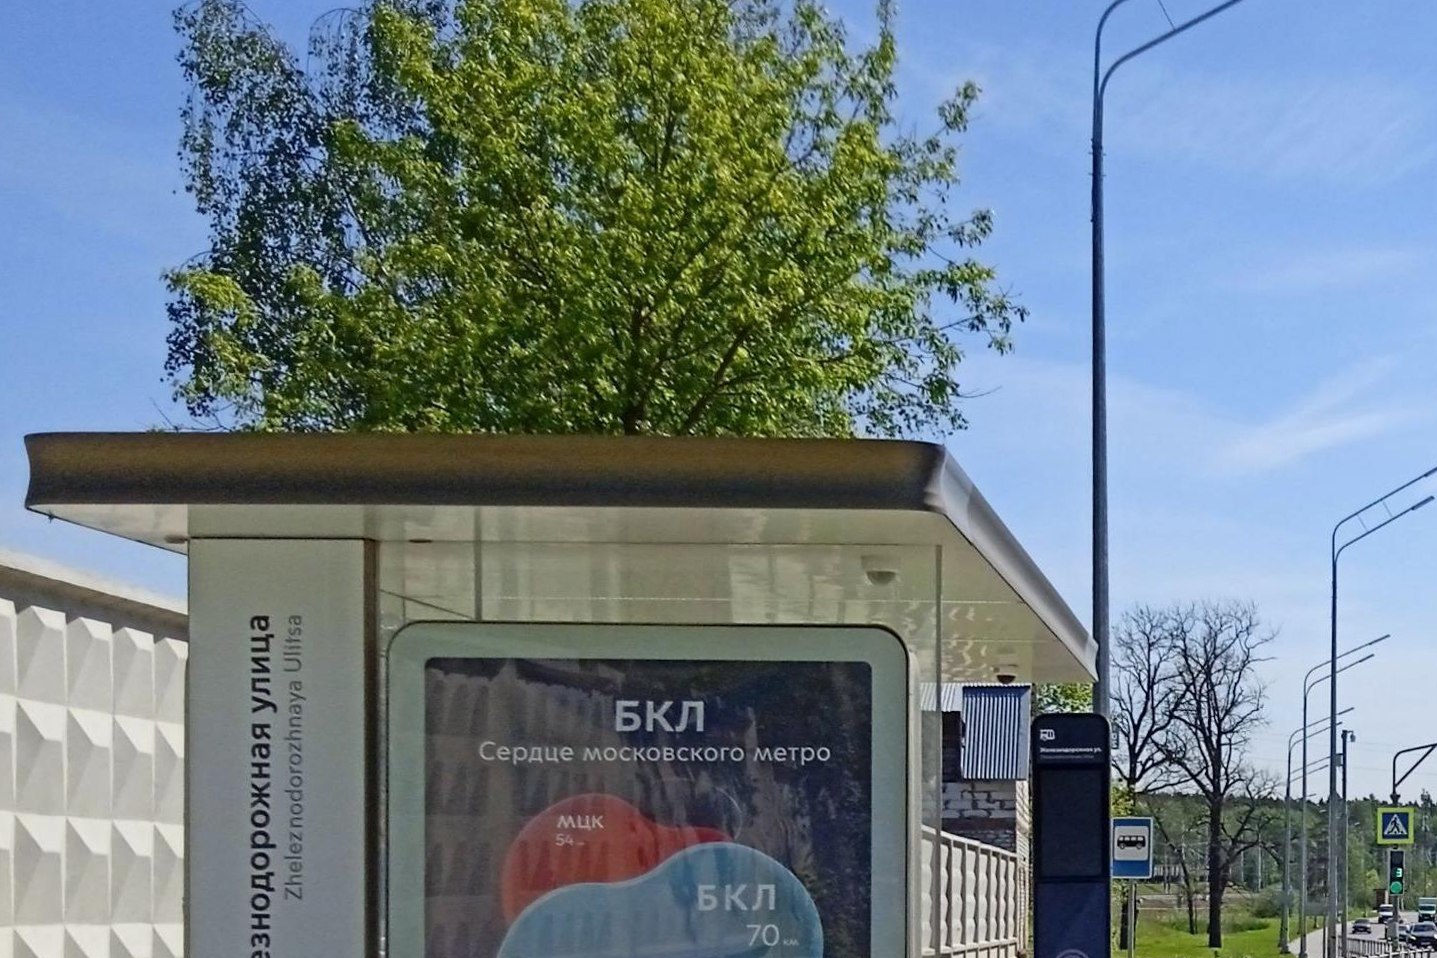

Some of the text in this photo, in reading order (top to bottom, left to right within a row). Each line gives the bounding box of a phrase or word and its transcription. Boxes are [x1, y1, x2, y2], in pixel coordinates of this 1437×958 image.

[250, 615, 277, 713] улица
[615, 700, 704, 732] БКЛ
[283, 614, 306, 900] Zheleznodorozhnaya Ulitsa
[479, 741, 831, 765] Сердце московского метро
[557, 815, 604, 831] МЦК
[555, 833, 574, 846] 54
[698, 883, 776, 911] БКЛ
[746, 923, 780, 947] 70
